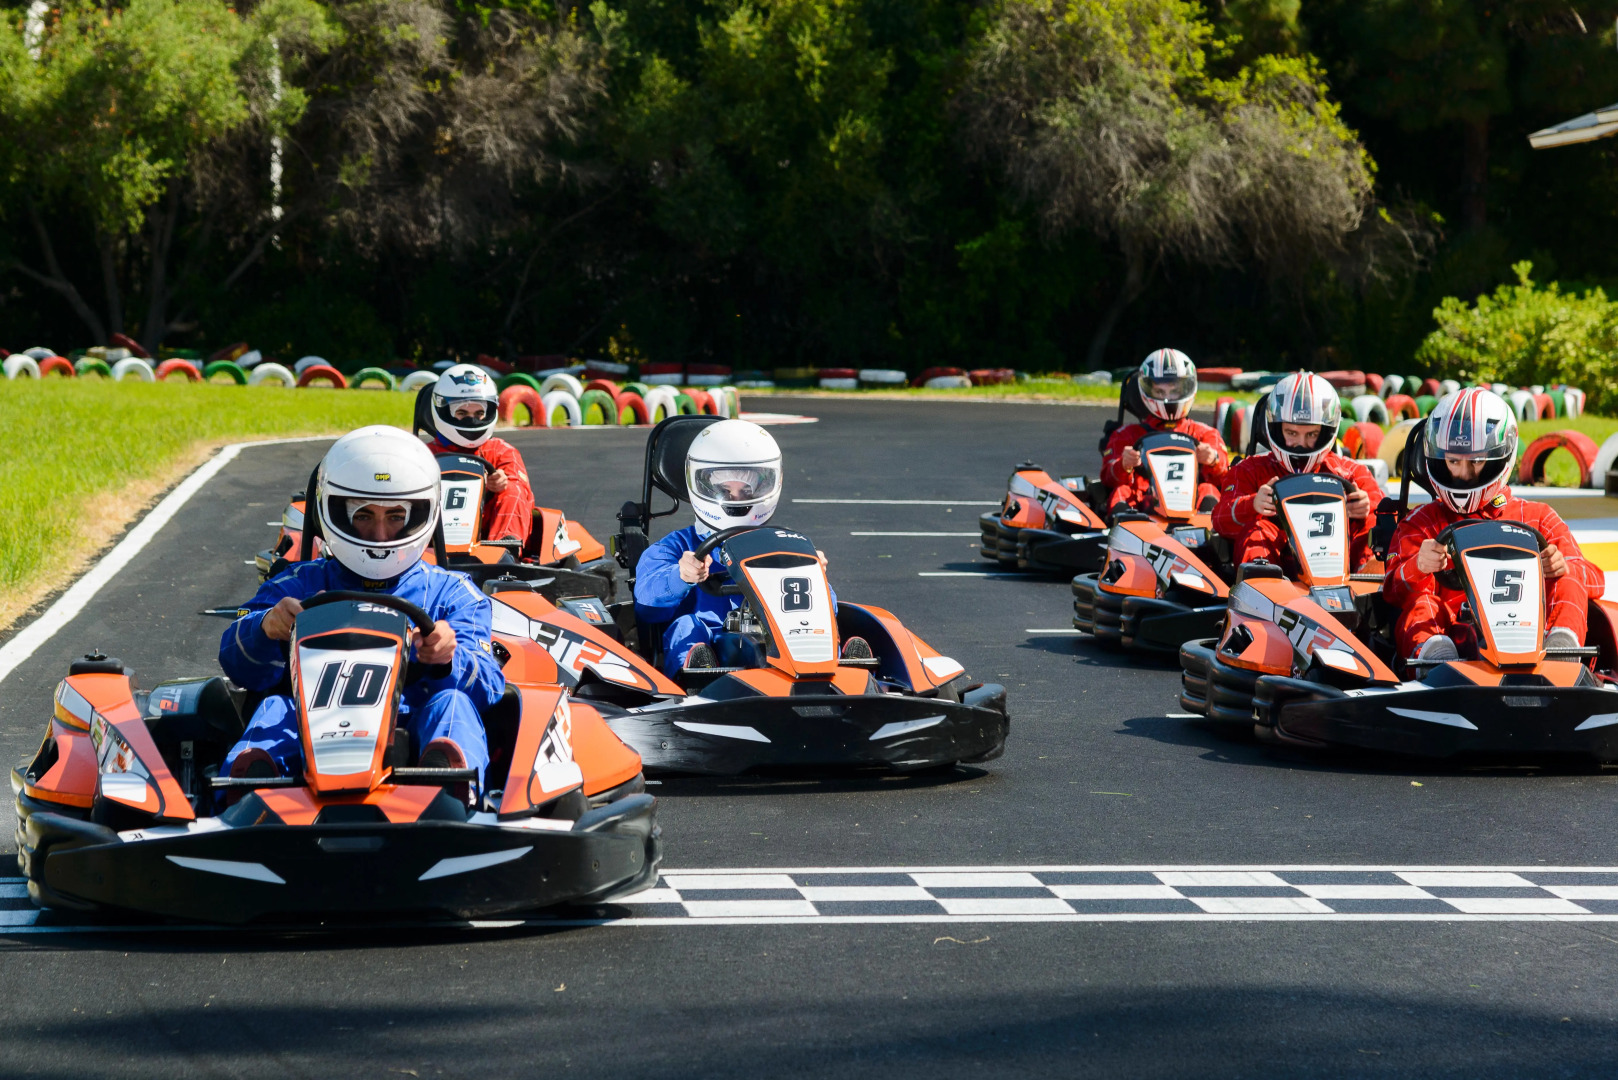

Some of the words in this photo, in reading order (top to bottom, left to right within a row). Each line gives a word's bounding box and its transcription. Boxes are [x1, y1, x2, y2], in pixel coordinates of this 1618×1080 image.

[1165, 462, 1186, 481] 2
[444, 487, 468, 511] 6
[1307, 511, 1335, 539] 3
[780, 576, 813, 613] 8
[1489, 568, 1526, 605] 5
[308, 660, 393, 711] 10
